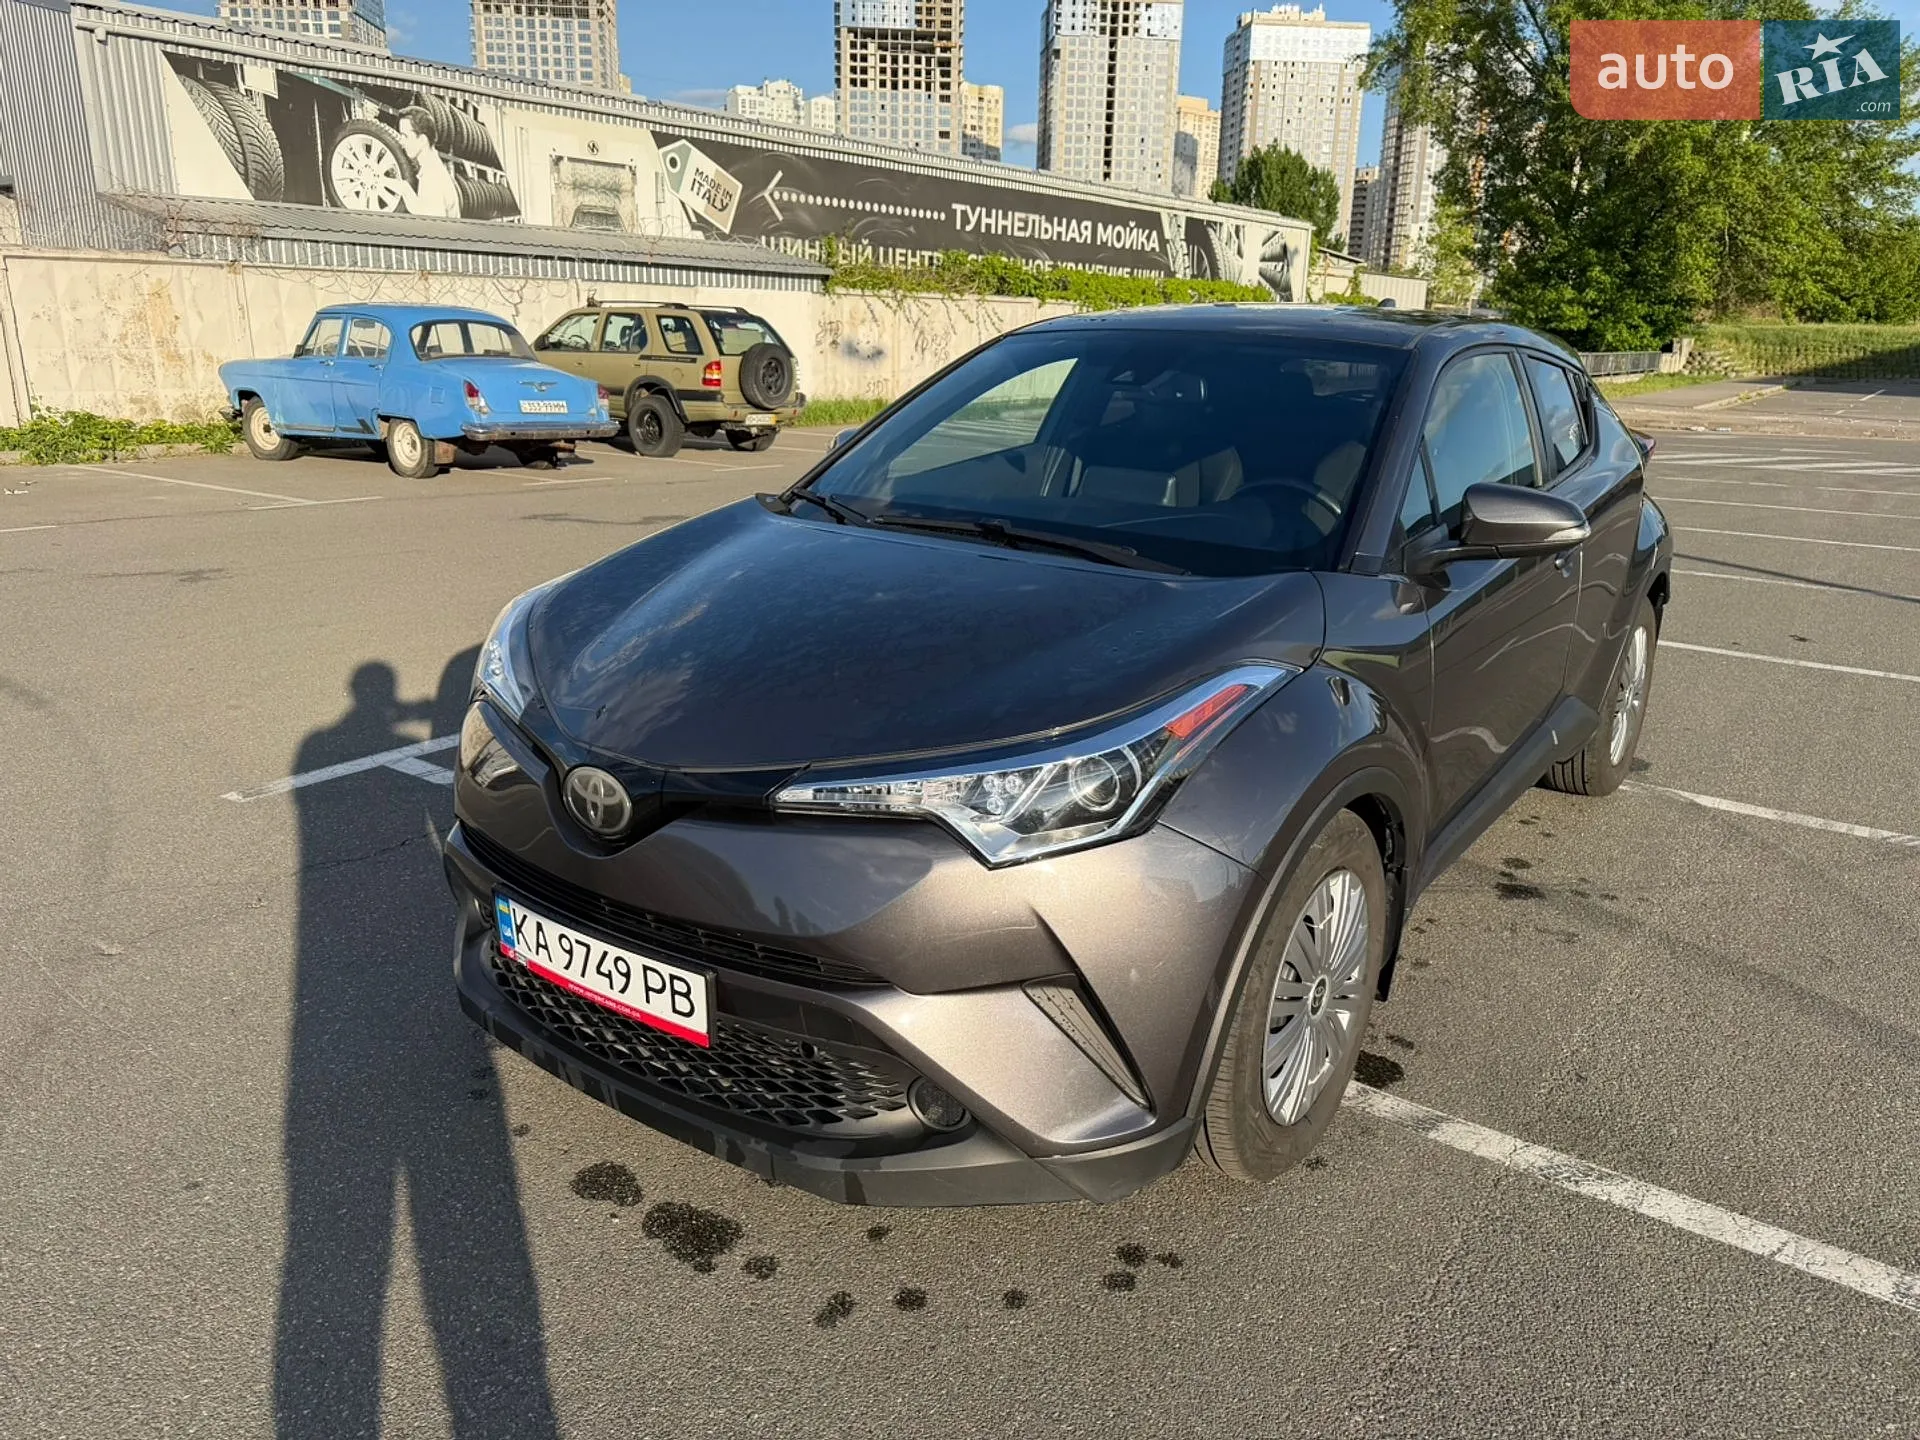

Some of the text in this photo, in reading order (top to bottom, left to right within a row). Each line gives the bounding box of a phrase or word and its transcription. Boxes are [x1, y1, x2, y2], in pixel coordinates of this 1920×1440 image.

[690, 178, 729, 212] ITALY
[695, 168, 722, 194] MADE
[951, 203, 1160, 253] ТУННЕЛЬНАЯ МОЙКА
[761, 235, 872, 266] ШИНЫЙ
[512, 907, 695, 1018] KA 9749 PB
